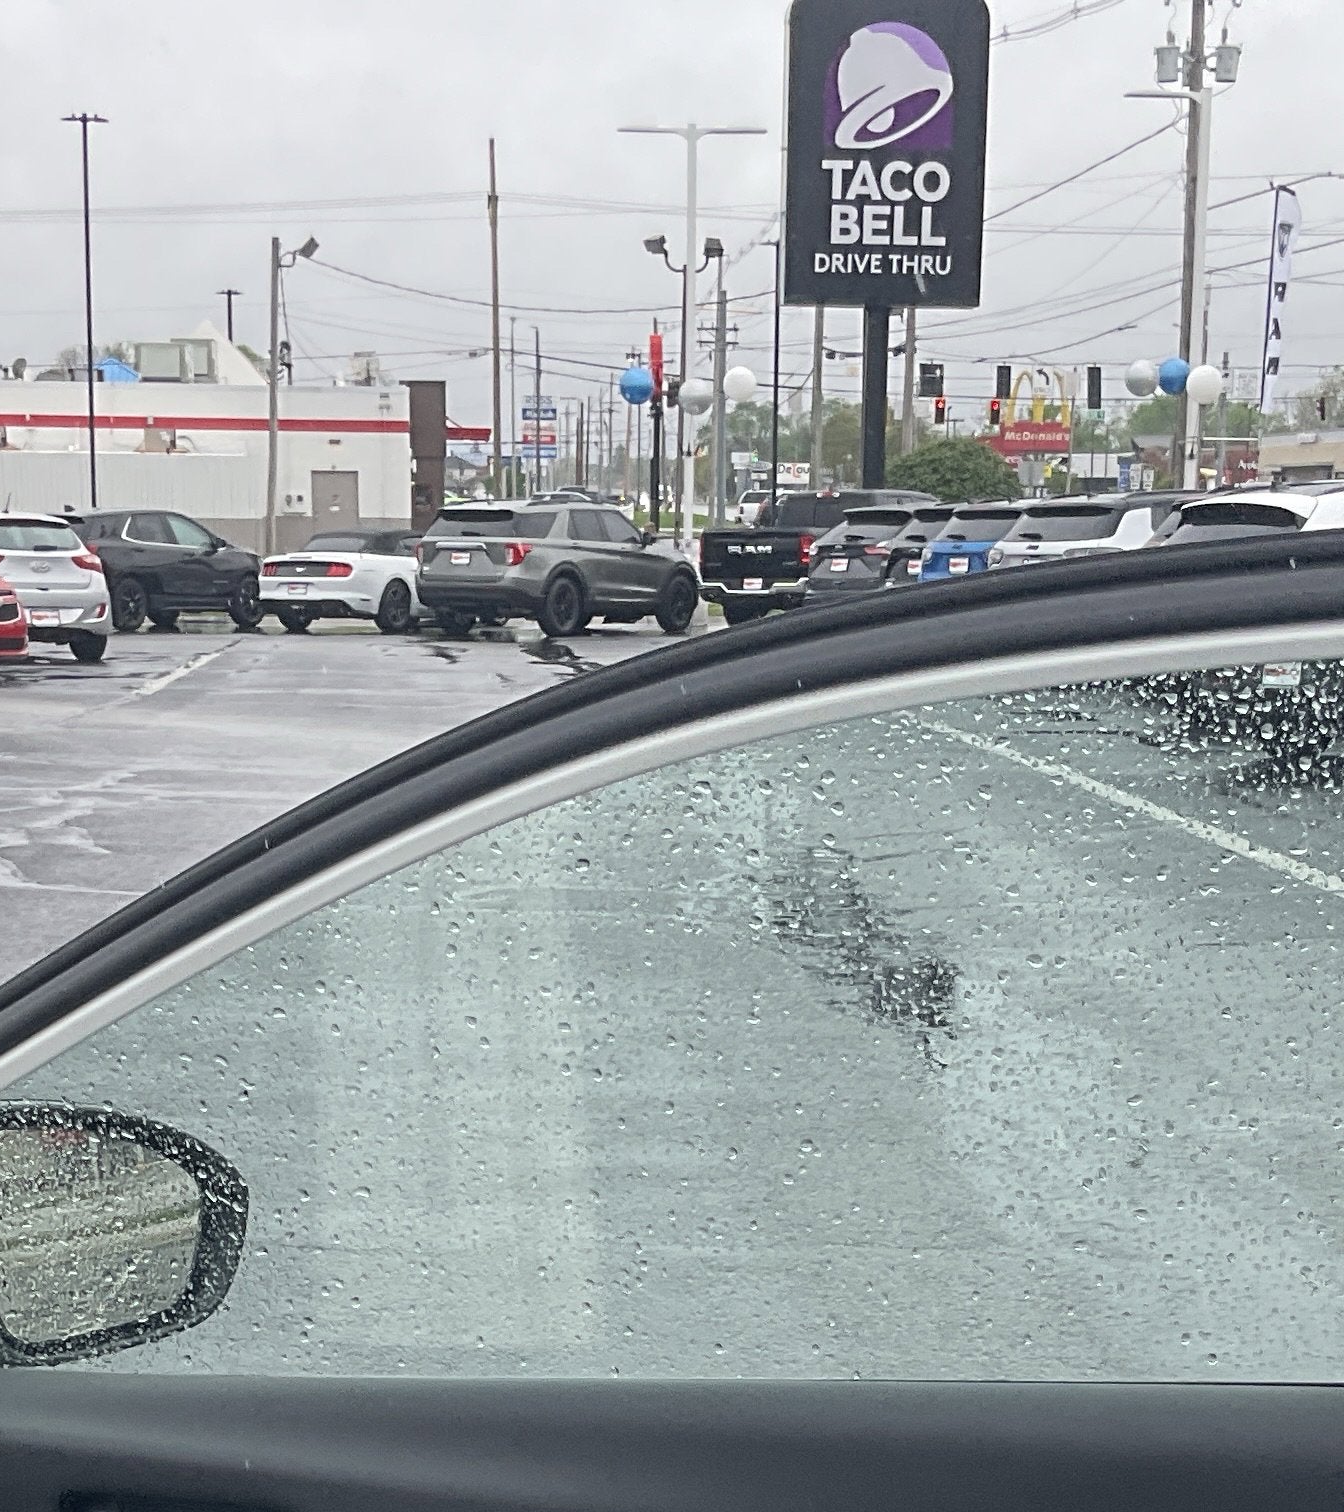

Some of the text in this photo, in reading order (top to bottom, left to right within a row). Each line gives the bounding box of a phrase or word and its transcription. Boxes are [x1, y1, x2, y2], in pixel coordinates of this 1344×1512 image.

[822, 160, 950, 202] TACO
[830, 205, 946, 246] BELL
[814, 253, 952, 275] DRIVE THRU
[727, 545, 772, 554] RAM
